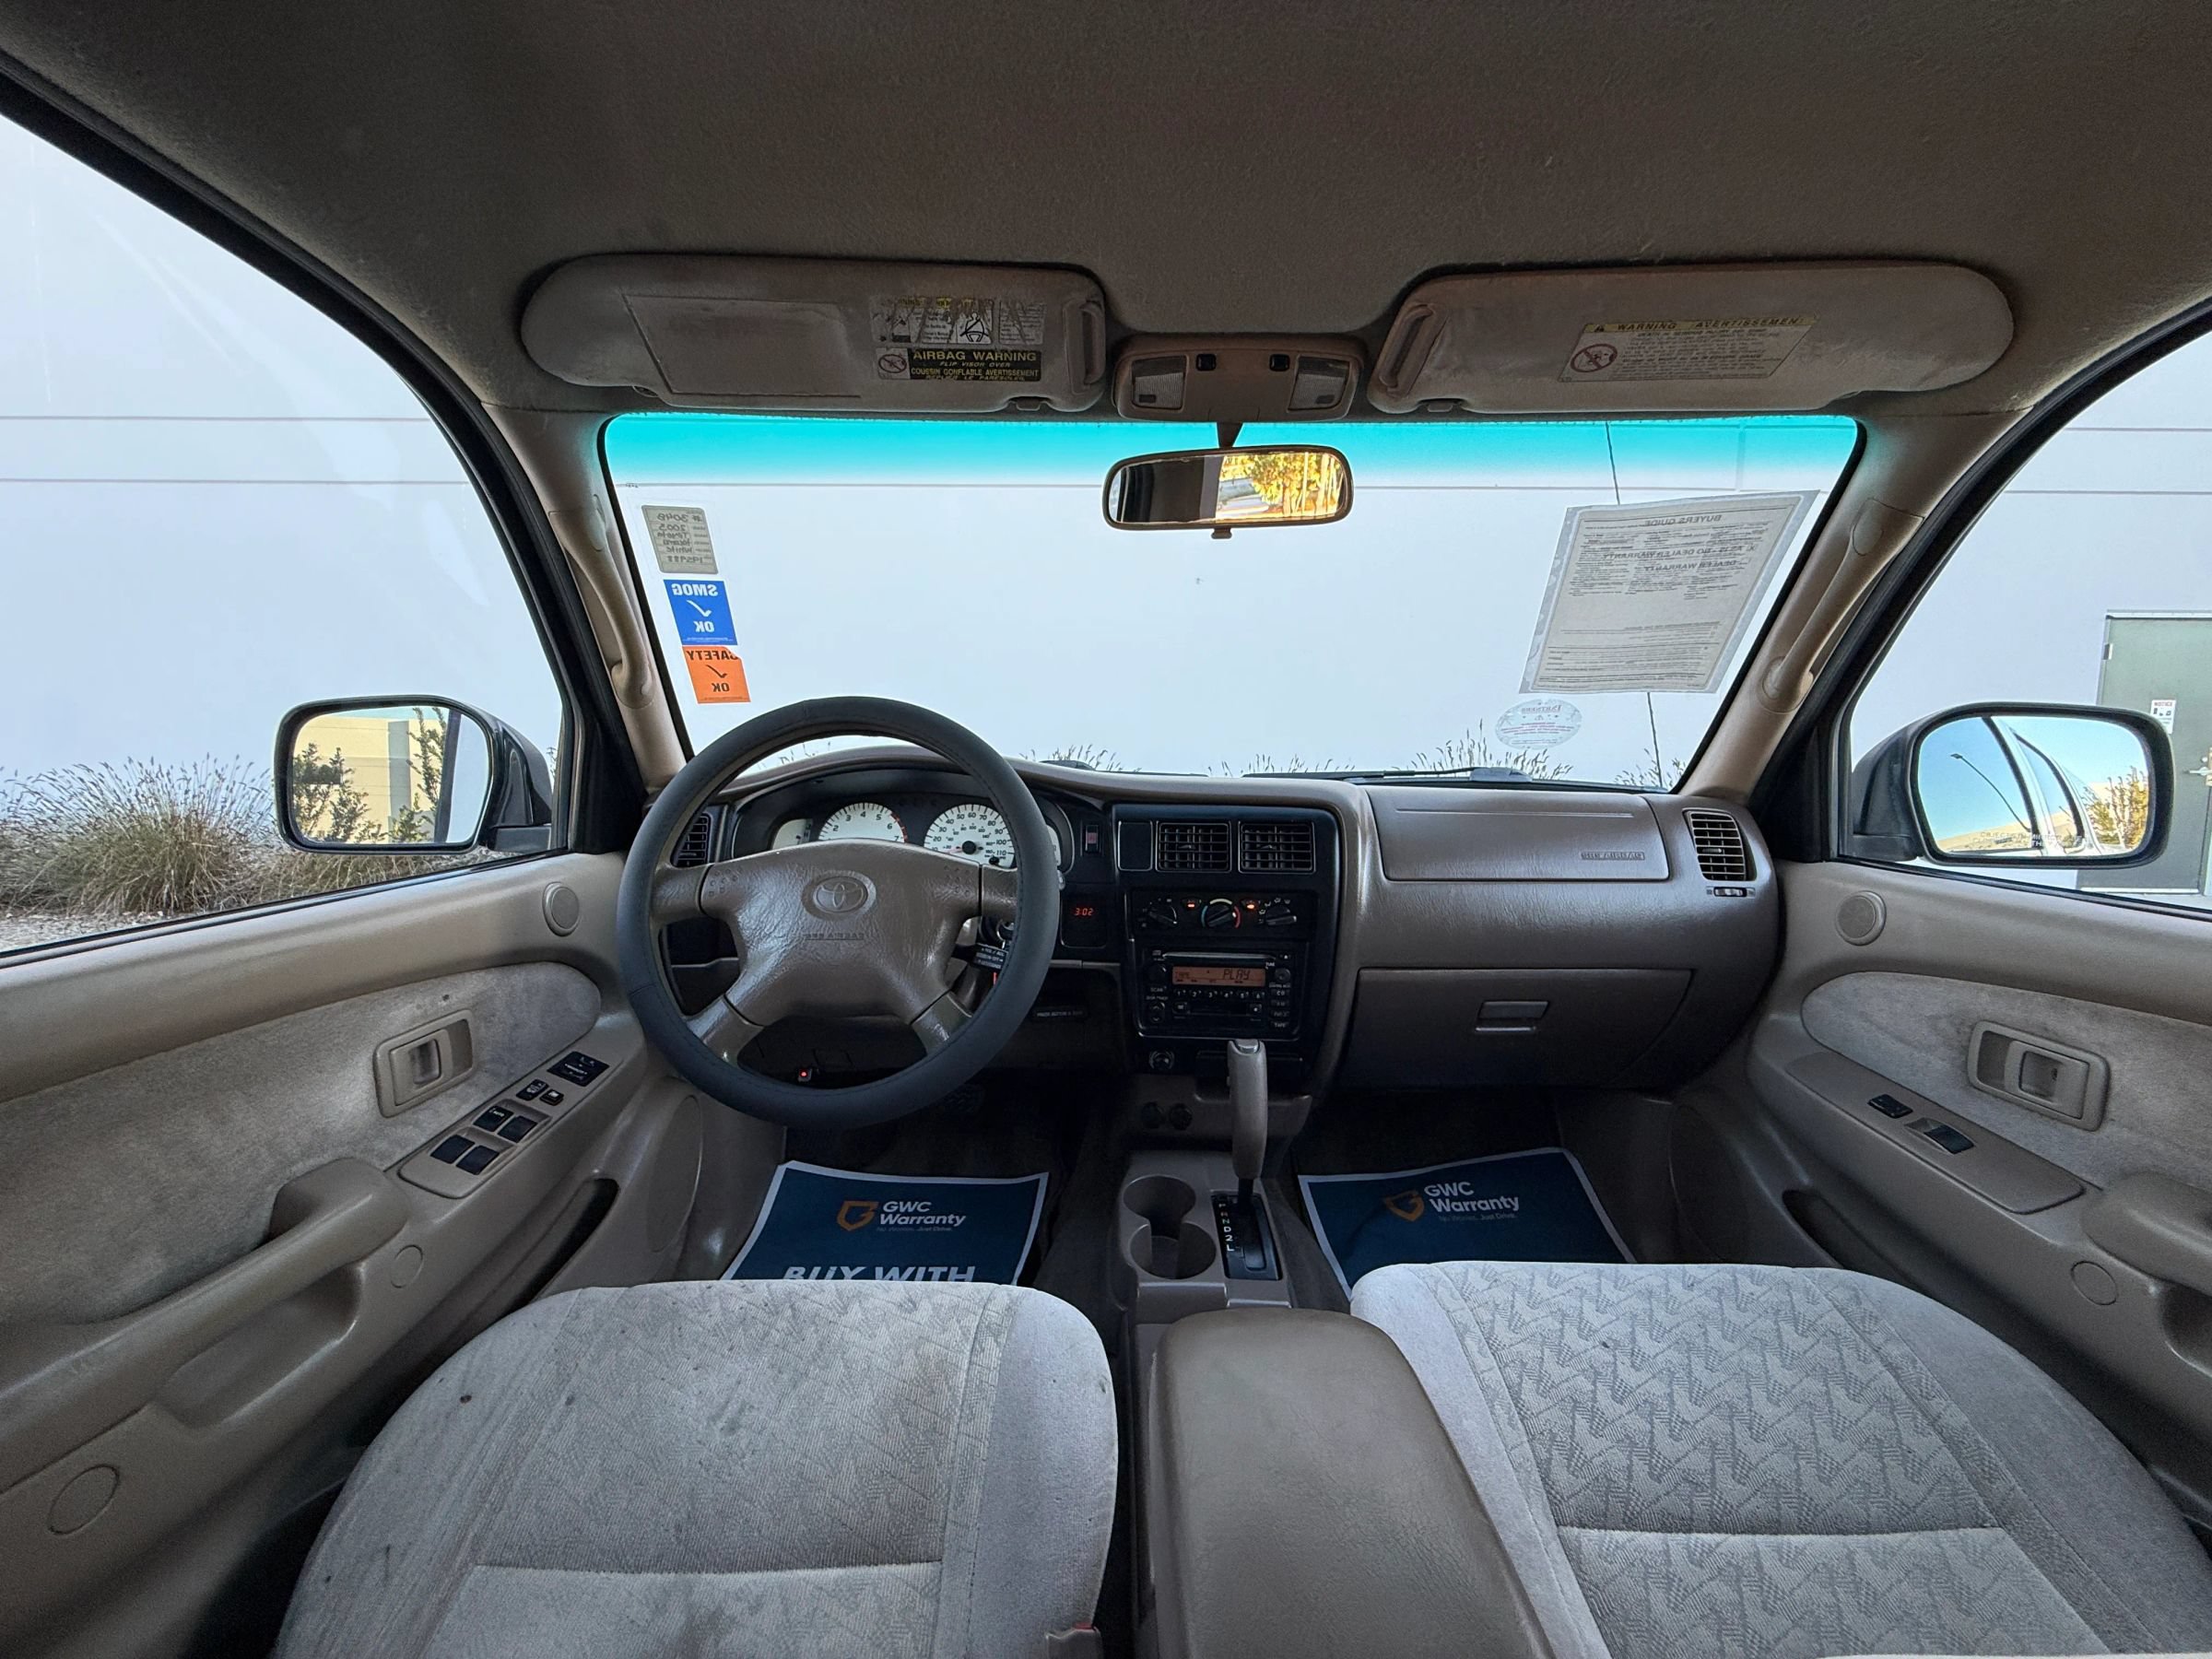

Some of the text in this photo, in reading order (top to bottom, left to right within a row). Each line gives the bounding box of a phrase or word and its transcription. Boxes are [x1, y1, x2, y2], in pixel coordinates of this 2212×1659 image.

[913, 351, 1037, 361] AIRBAG WARNING
[943, 368, 982, 376] GONFLABLE
[1221, 968, 1252, 980] PLAY
[1424, 1181, 1475, 1197] GWC
[882, 1201, 931, 1213] GWC
[1429, 1195, 1519, 1212] Warranty
[879, 1213, 967, 1227] Warranty
[1226, 1243, 1235, 1252] L
[875, 1265, 976, 1282] WITH
